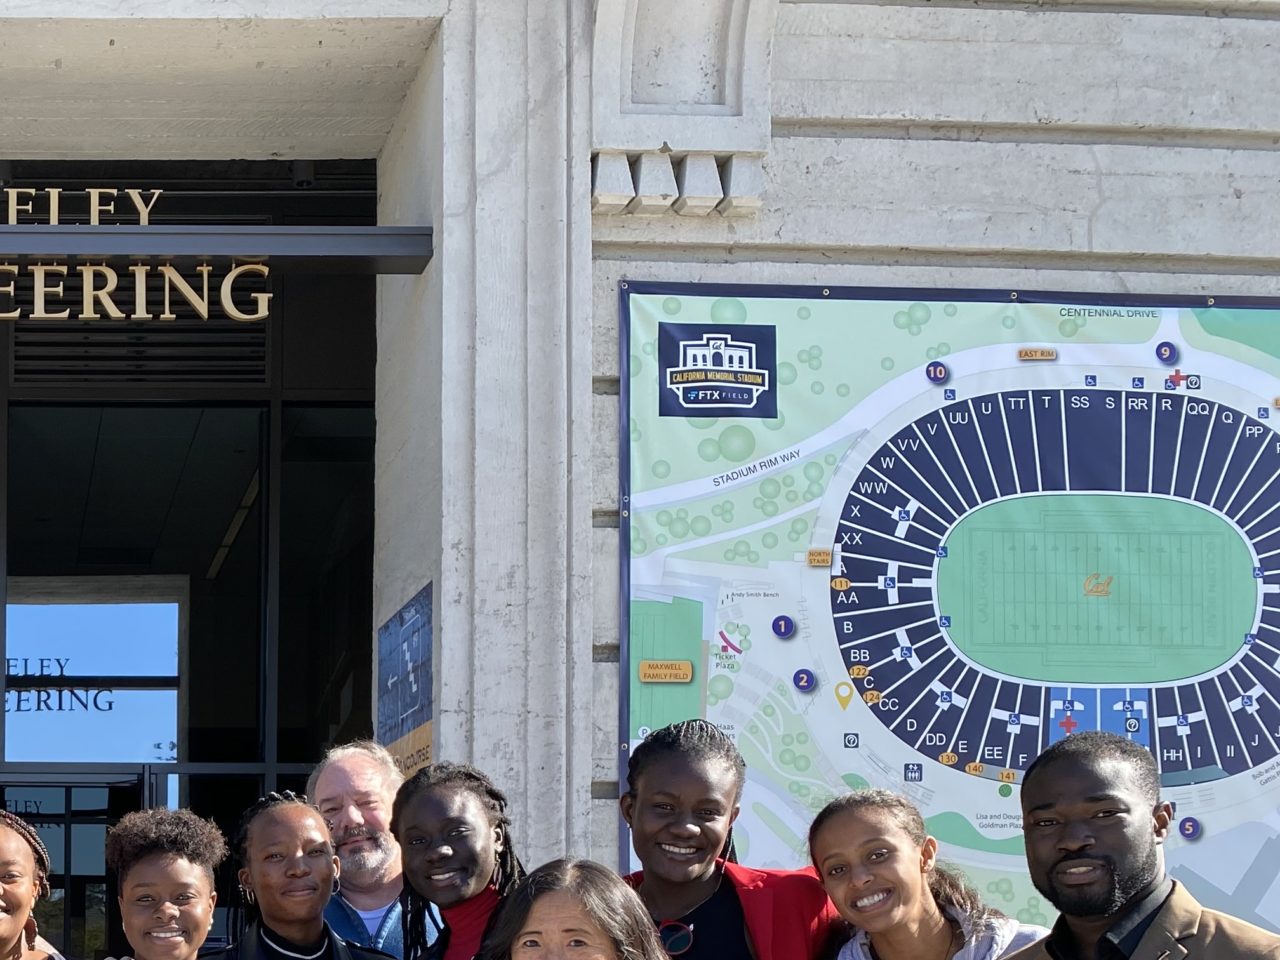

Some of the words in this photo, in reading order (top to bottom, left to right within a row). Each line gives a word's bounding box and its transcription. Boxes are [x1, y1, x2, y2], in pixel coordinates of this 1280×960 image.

[1059, 308, 1124, 317] CENTENNIAL
[1161, 347, 1170, 358] 9
[672, 372, 706, 382] CALIFORNIA
[708, 372, 735, 381] MEMORIAL
[738, 373, 762, 384] STADIUM
[928, 366, 945, 378] 10
[698, 390, 720, 400] FTX
[982, 402, 992, 414] U
[1008, 398, 1026, 410] TT
[1042, 396, 1052, 408] T
[1071, 396, 1090, 408] SS
[1105, 397, 1115, 409] S
[1128, 398, 1148, 410] RR
[1162, 399, 1172, 410] R
[1187, 403, 1210, 416] QQ
[950, 412, 968, 424] UU
[1222, 411, 1233, 424] Q
[927, 424, 938, 435] V
[1246, 426, 1264, 437] PP
[898, 438, 920, 450] VV
[713, 464, 758, 486] STADIUM
[760, 458, 779, 470] RIM
[780, 450, 800, 462] WAY
[881, 457, 894, 468] W
[859, 482, 888, 494] WW
[851, 506, 860, 517] X
[842, 533, 862, 544] XX
[837, 592, 858, 604] AA
[779, 620, 785, 632] 1
[844, 622, 853, 633] B
[850, 650, 870, 661] BB
[799, 674, 808, 686] 2
[864, 676, 874, 688] C
[879, 698, 898, 710] CC
[907, 720, 917, 730] D
[926, 734, 946, 746] DD
[1252, 734, 1258, 746] J
[958, 741, 968, 752] E
[985, 747, 1002, 758] EE
[1226, 745, 1234, 757] II
[940, 754, 956, 763] 130
[1018, 754, 1027, 766] F
[1164, 750, 1182, 760] HH
[968, 764, 984, 773] 140
[1000, 772, 1015, 780] 141
[1184, 822, 1193, 834] 5
